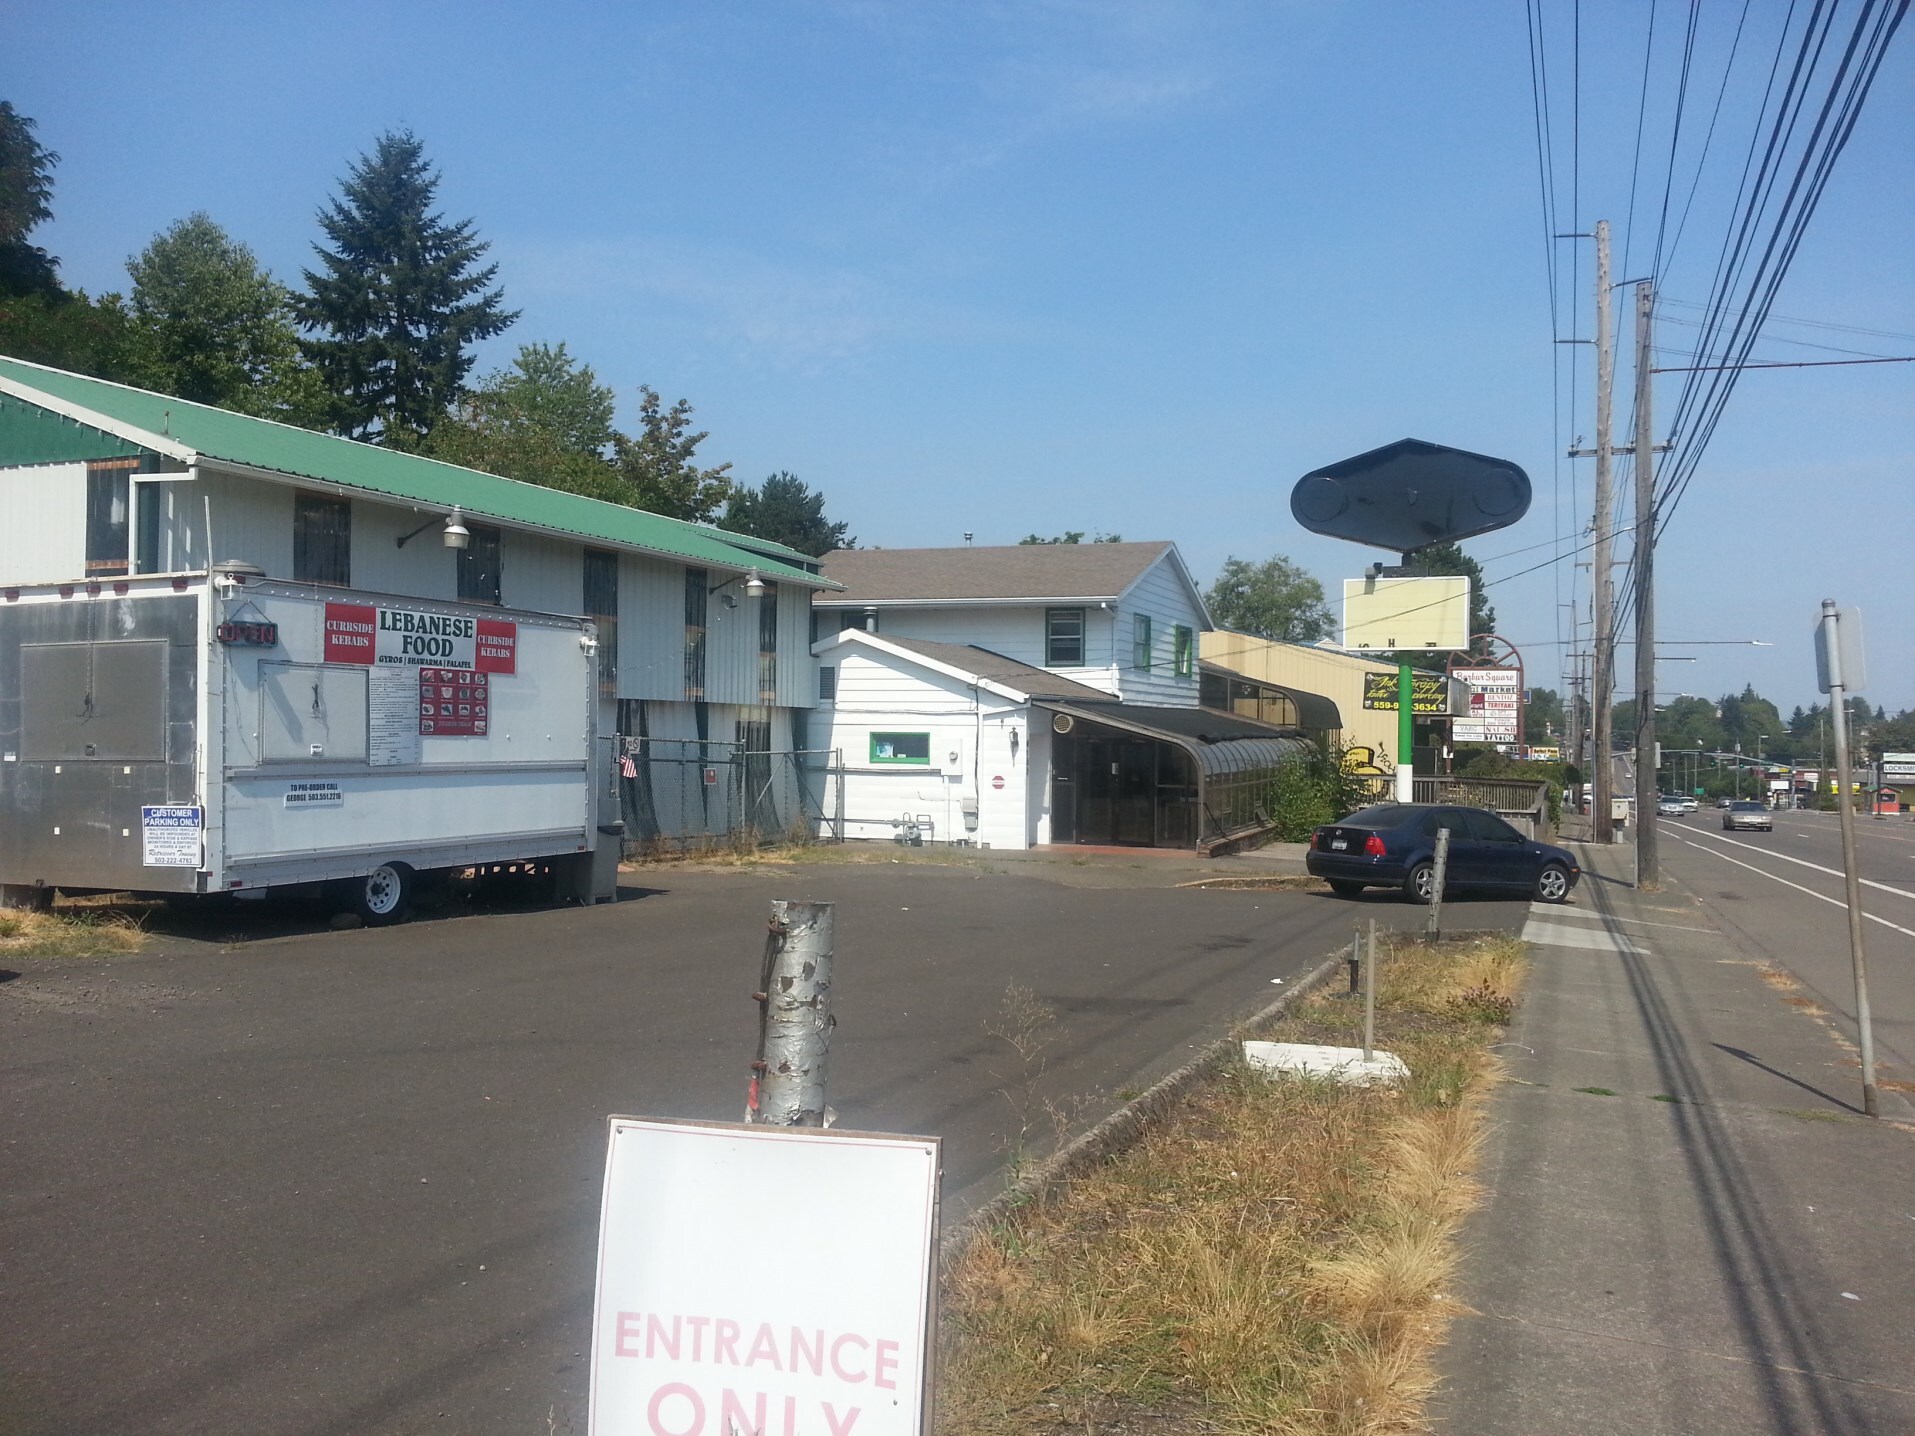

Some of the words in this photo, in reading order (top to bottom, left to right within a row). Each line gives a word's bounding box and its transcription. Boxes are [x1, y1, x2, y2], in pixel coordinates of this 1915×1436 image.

[326, 620, 374, 634] CURBSIDE
[380, 610, 473, 638] LEBANESE
[331, 634, 369, 647] KEBABS
[477, 634, 515, 646] CURBSIDE
[402, 635, 453, 658] FOOD
[480, 647, 510, 658] KEBABS
[378, 655, 403, 664] GYROS
[407, 658, 442, 667] SHAWARMA
[447, 660, 472, 668] FALAFEL
[1485, 671, 1514, 683] Square
[1373, 701, 1437, 711] 559-9-3634
[290, 784, 298, 792] TO
[298, 783, 326, 791] PRE-ORDER
[326, 783, 338, 791] CALL
[286, 794, 307, 802] GEORGE
[151, 809, 193, 817] CUSTOMER
[144, 818, 178, 826] PARKING
[179, 818, 199, 827] ONLY
[614, 1311, 900, 1391] ENTRANCE
[647, 1382, 862, 1436] ONLY
